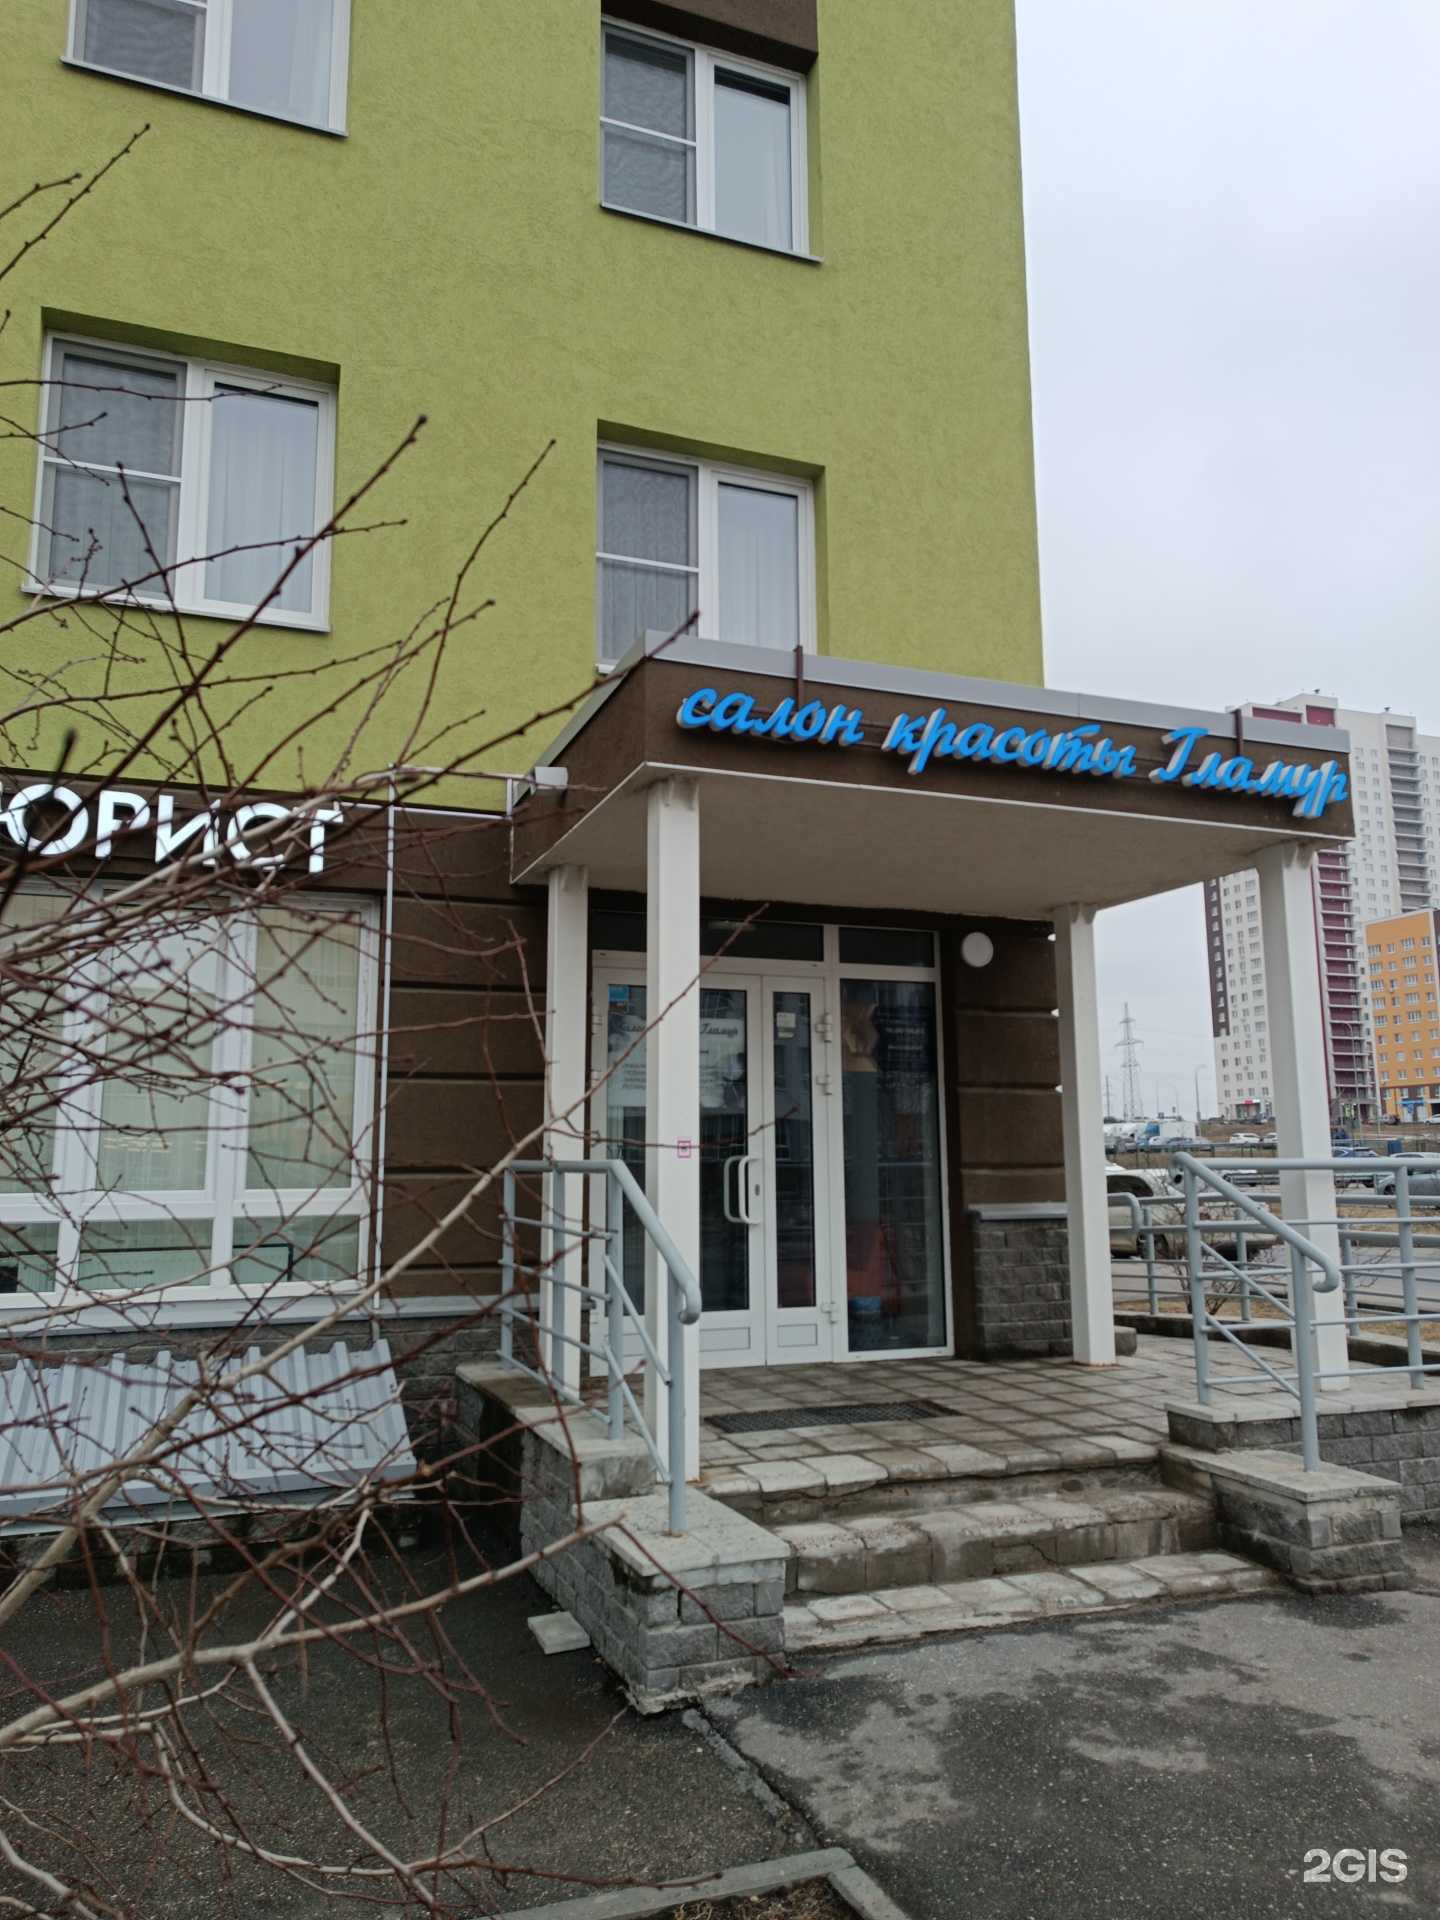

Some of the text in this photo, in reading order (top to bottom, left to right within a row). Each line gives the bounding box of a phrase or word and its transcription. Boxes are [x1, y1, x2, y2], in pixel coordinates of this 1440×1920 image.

[677, 687, 1348, 819] салон красоты Гламур
